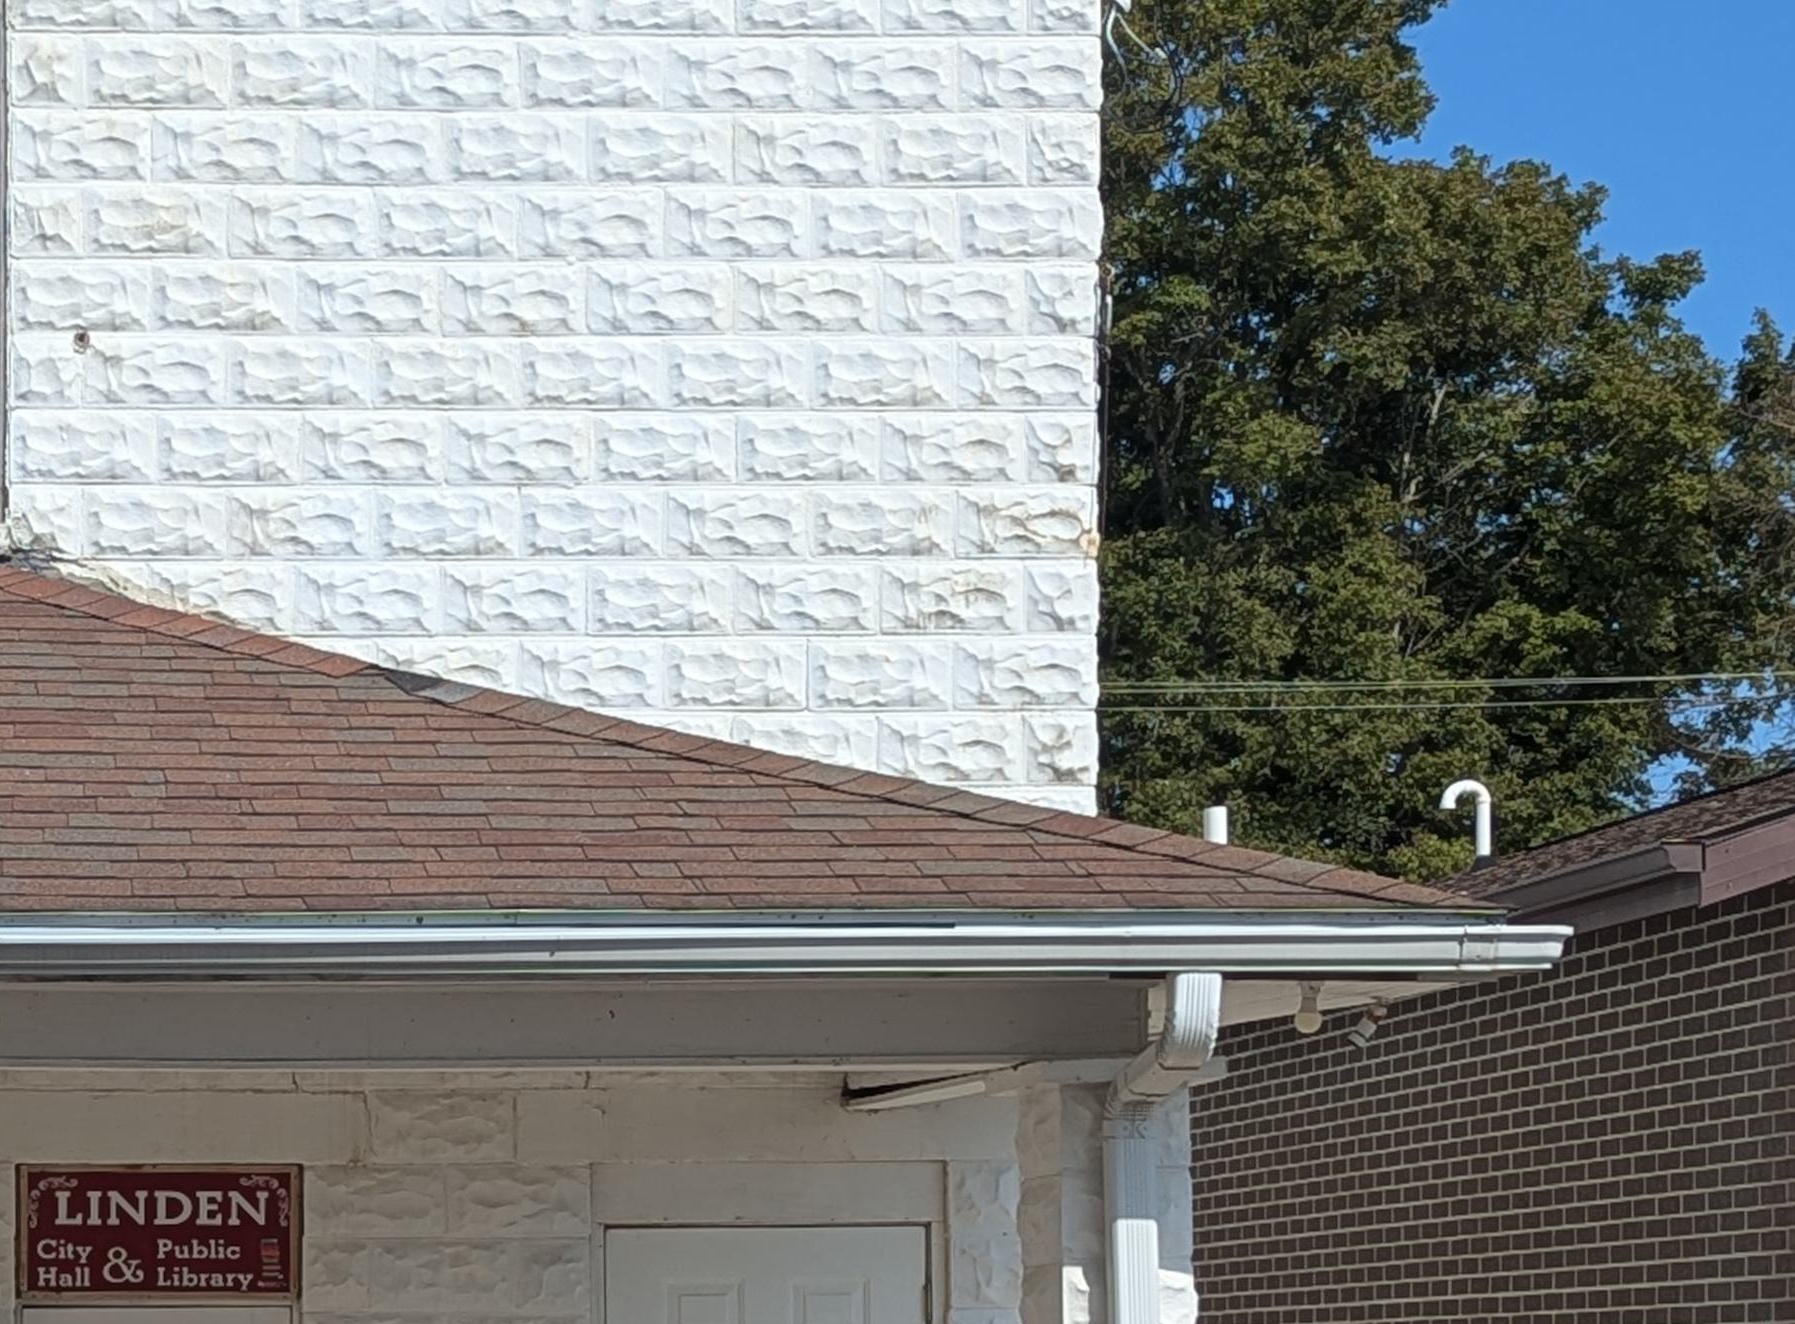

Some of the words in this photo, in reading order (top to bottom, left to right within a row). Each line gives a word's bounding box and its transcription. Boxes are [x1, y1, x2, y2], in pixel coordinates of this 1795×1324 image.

[54, 1190, 269, 1226] LINDEN
[36, 1239, 93, 1264] City
[156, 1239, 241, 1260] Public
[36, 1266, 91, 1288] Hall
[103, 1246, 145, 1284] &
[156, 1266, 253, 1291] Library
